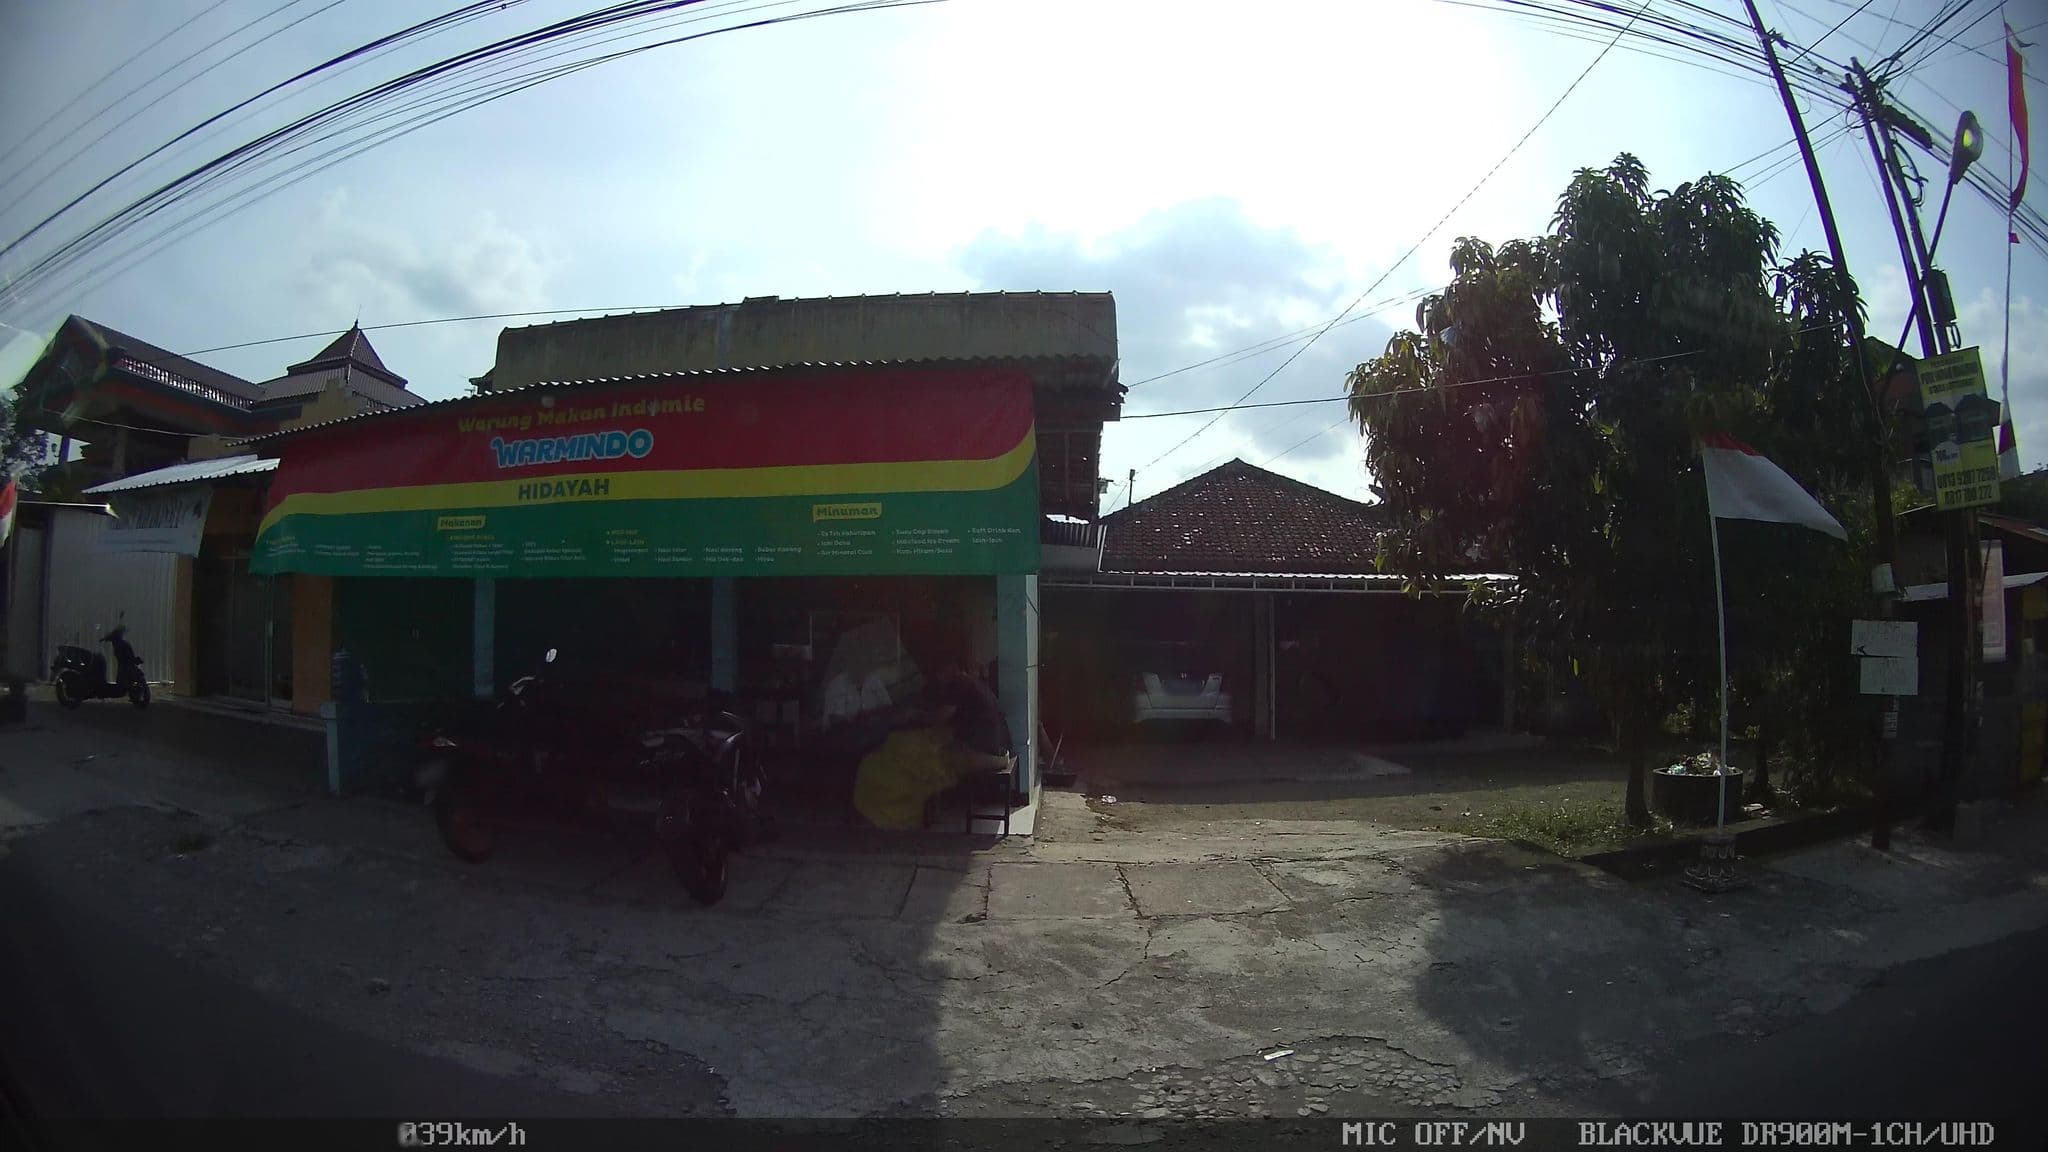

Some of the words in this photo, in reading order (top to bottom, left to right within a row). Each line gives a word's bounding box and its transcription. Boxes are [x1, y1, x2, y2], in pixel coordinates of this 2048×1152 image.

[458, 414, 532, 433] Warung
[537, 407, 606, 425] Makan
[612, 396, 705, 418] Indomie
[491, 428, 654, 468] WARMINDO
[518, 478, 610, 501] HIDAYAH
[816, 505, 879, 517] Minuman
